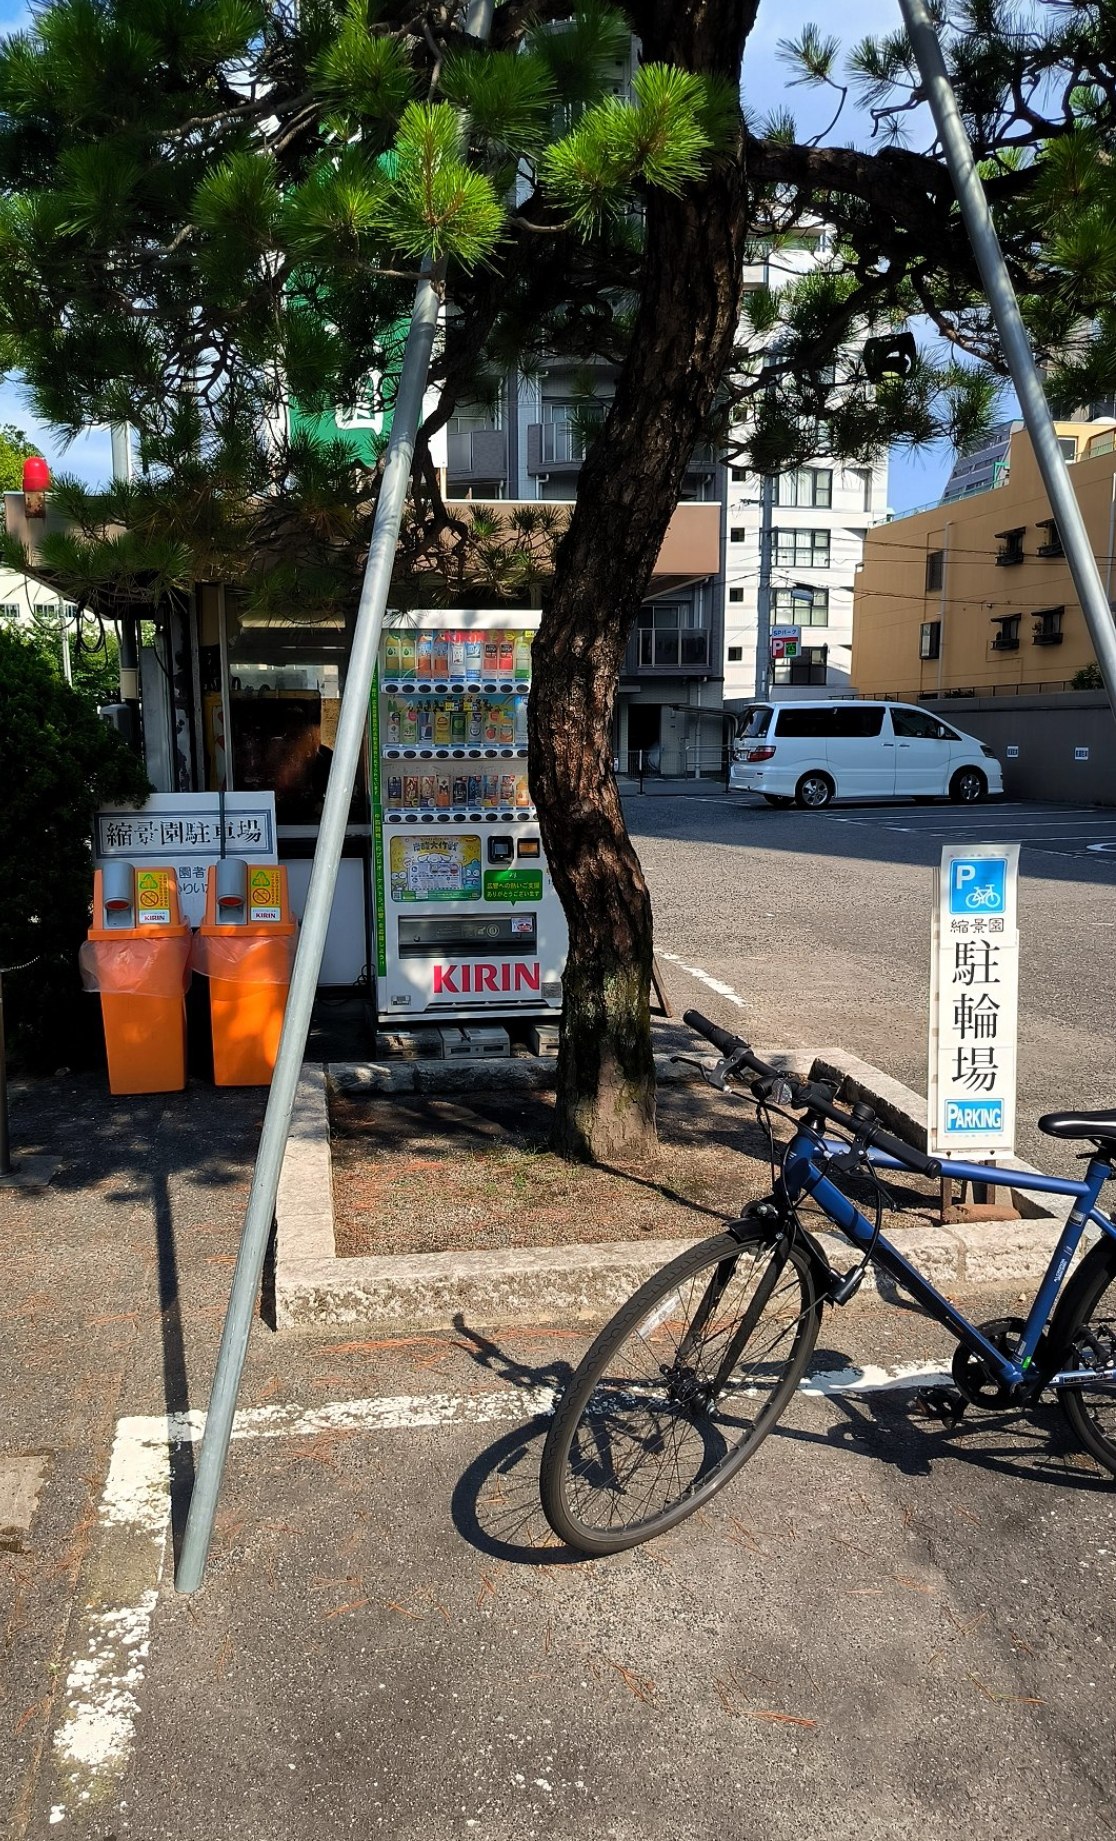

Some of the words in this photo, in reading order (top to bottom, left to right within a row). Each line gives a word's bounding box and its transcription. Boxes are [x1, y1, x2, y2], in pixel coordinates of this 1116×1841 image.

[773, 640, 784, 656] P
[106, 819, 262, 847] 縮景園駐車場
[956, 865, 976, 890] P
[950, 918, 1004, 934] 縮景園
[433, 962, 540, 994] KIRIN
[952, 939, 1001, 1092] 駐輪場
